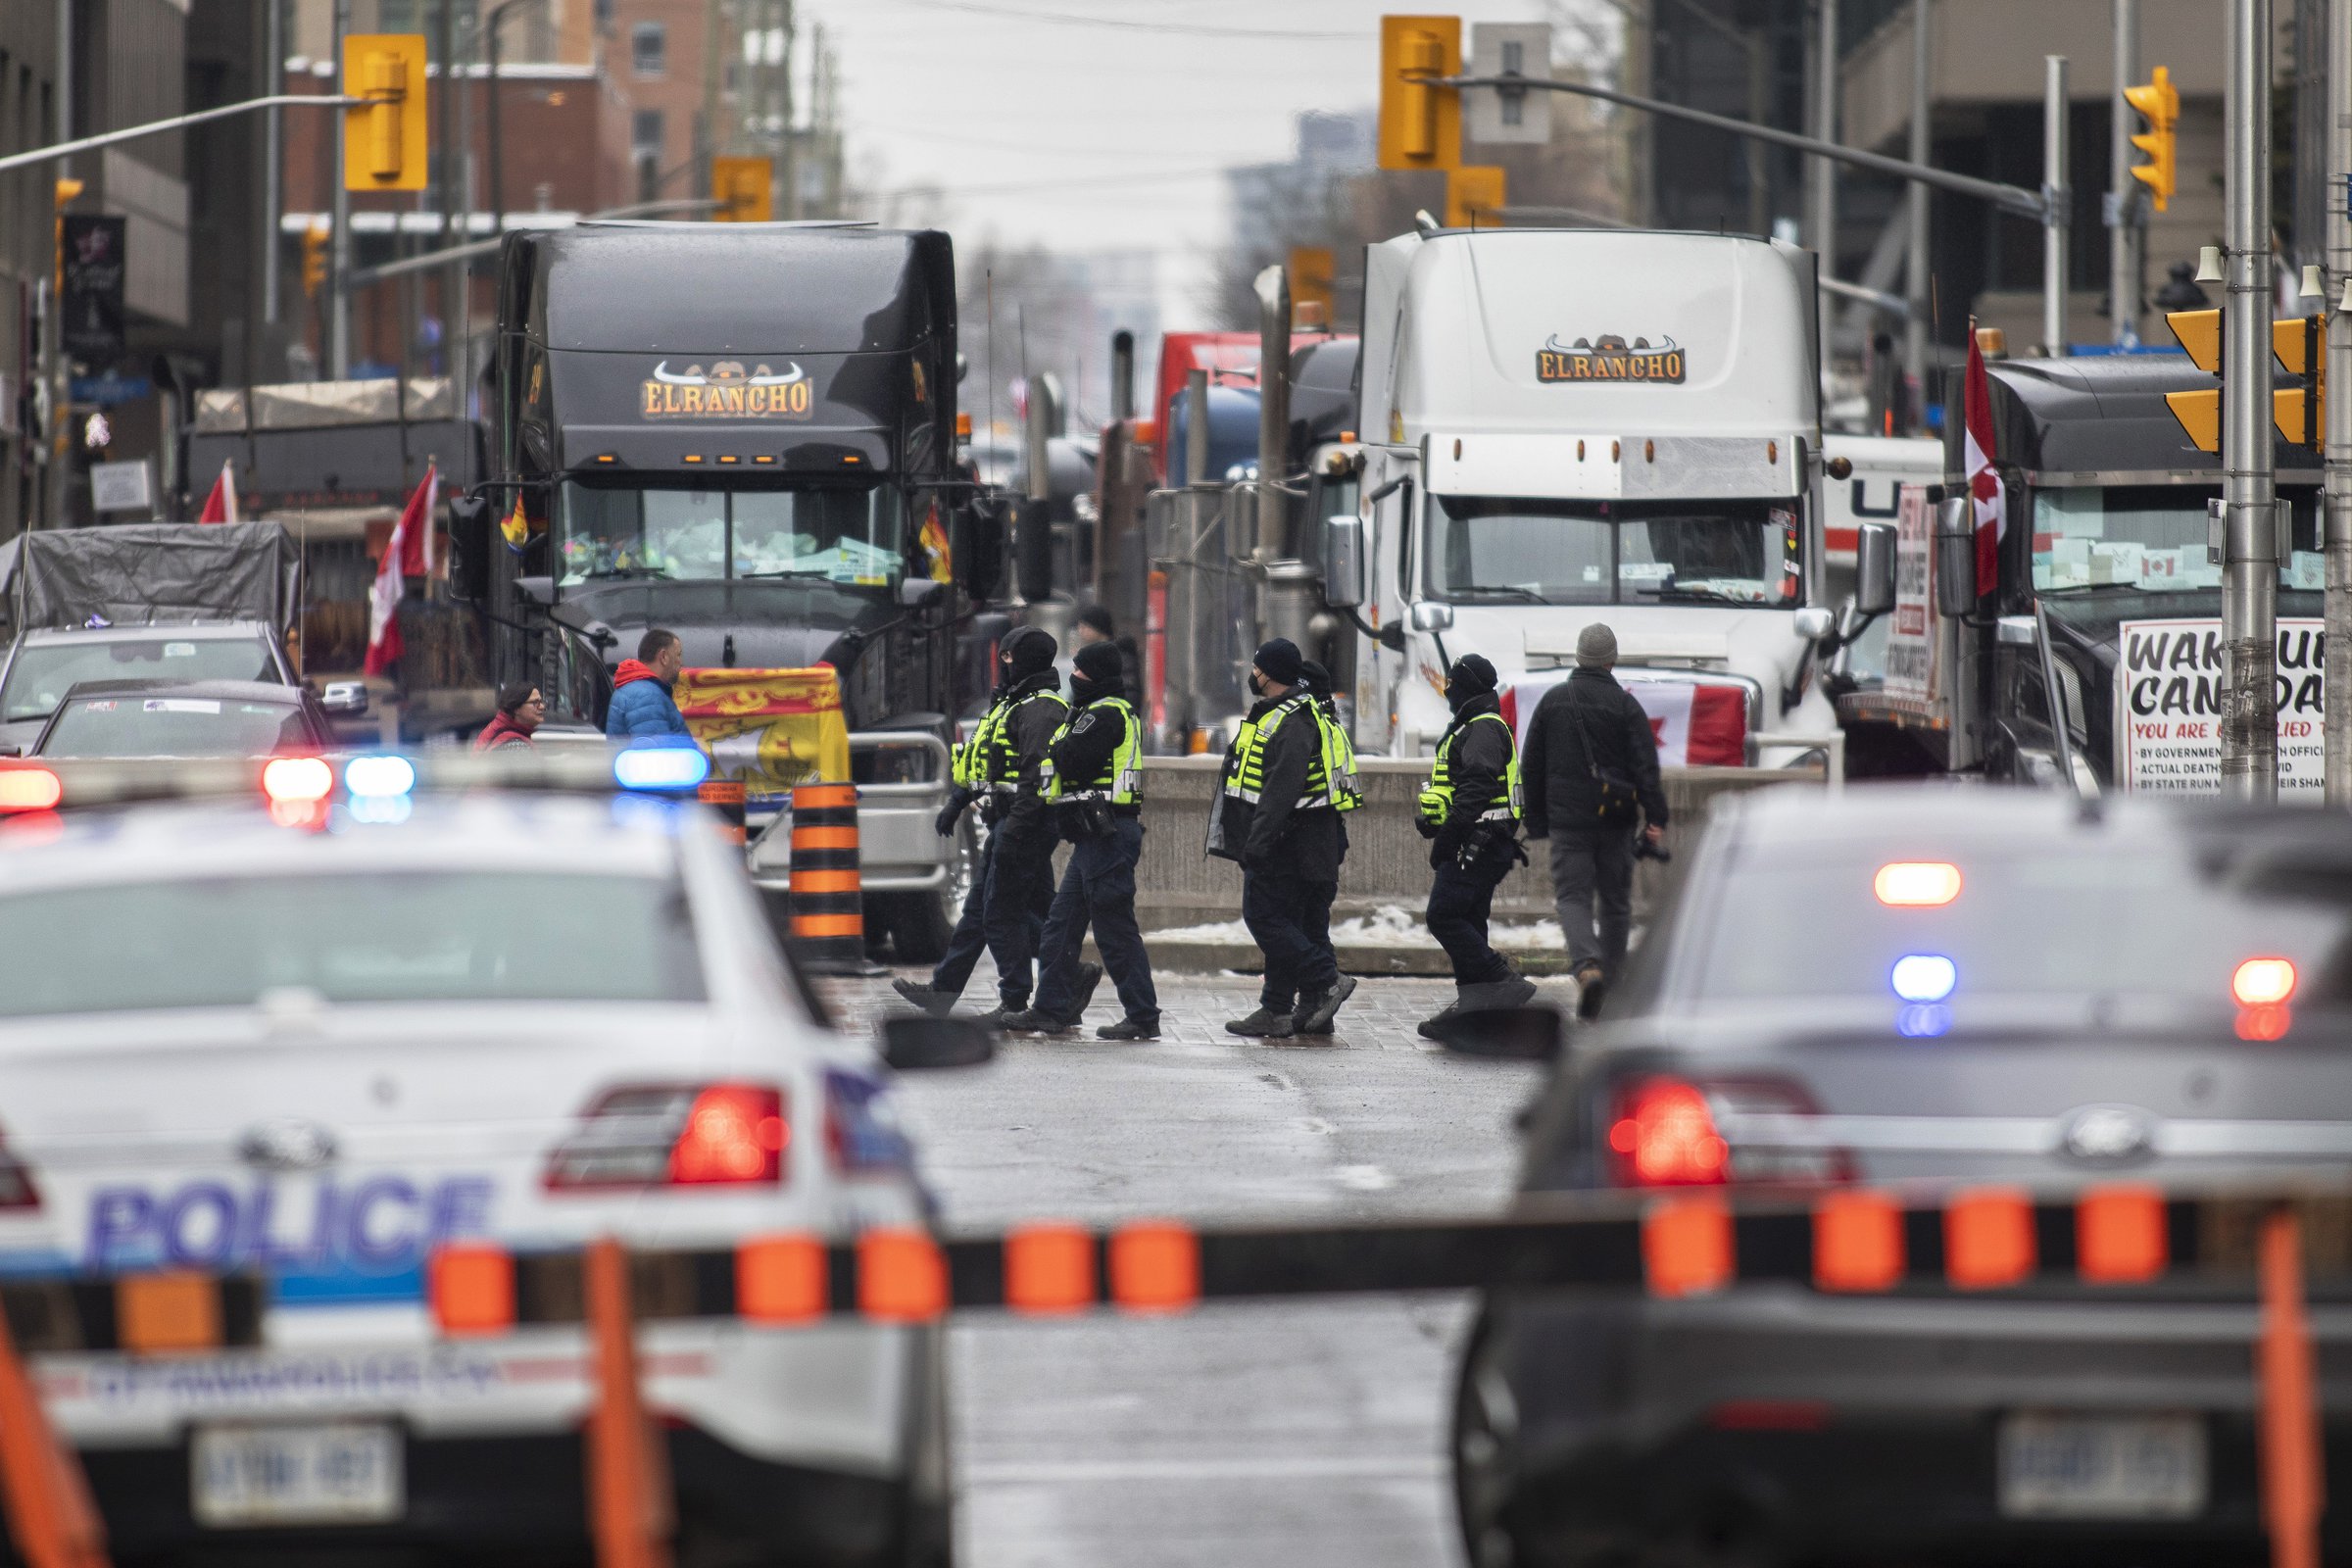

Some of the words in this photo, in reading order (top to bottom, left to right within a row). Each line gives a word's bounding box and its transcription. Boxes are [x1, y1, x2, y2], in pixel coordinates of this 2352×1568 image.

[1540, 352, 1682, 379] ELRANCHO
[644, 381, 808, 414] ELRANCHO
[2128, 631, 2223, 672] WAK
[2131, 673, 2324, 716] CANDA
[2134, 722, 2169, 739] YOU
[2176, 721, 2209, 739] ARE
[2140, 748, 2152, 759] BY
[2155, 747, 2222, 759] GOVERNMEN
[2289, 746, 2324, 758] OFFICI
[2140, 763, 2181, 775] ACTUAL
[2140, 779, 2153, 789] BY
[2156, 779, 2187, 790] STATE
[2190, 779, 2212, 789] RUN
[2279, 777, 2297, 788] EIR
[86, 1175, 496, 1270] POLICE
